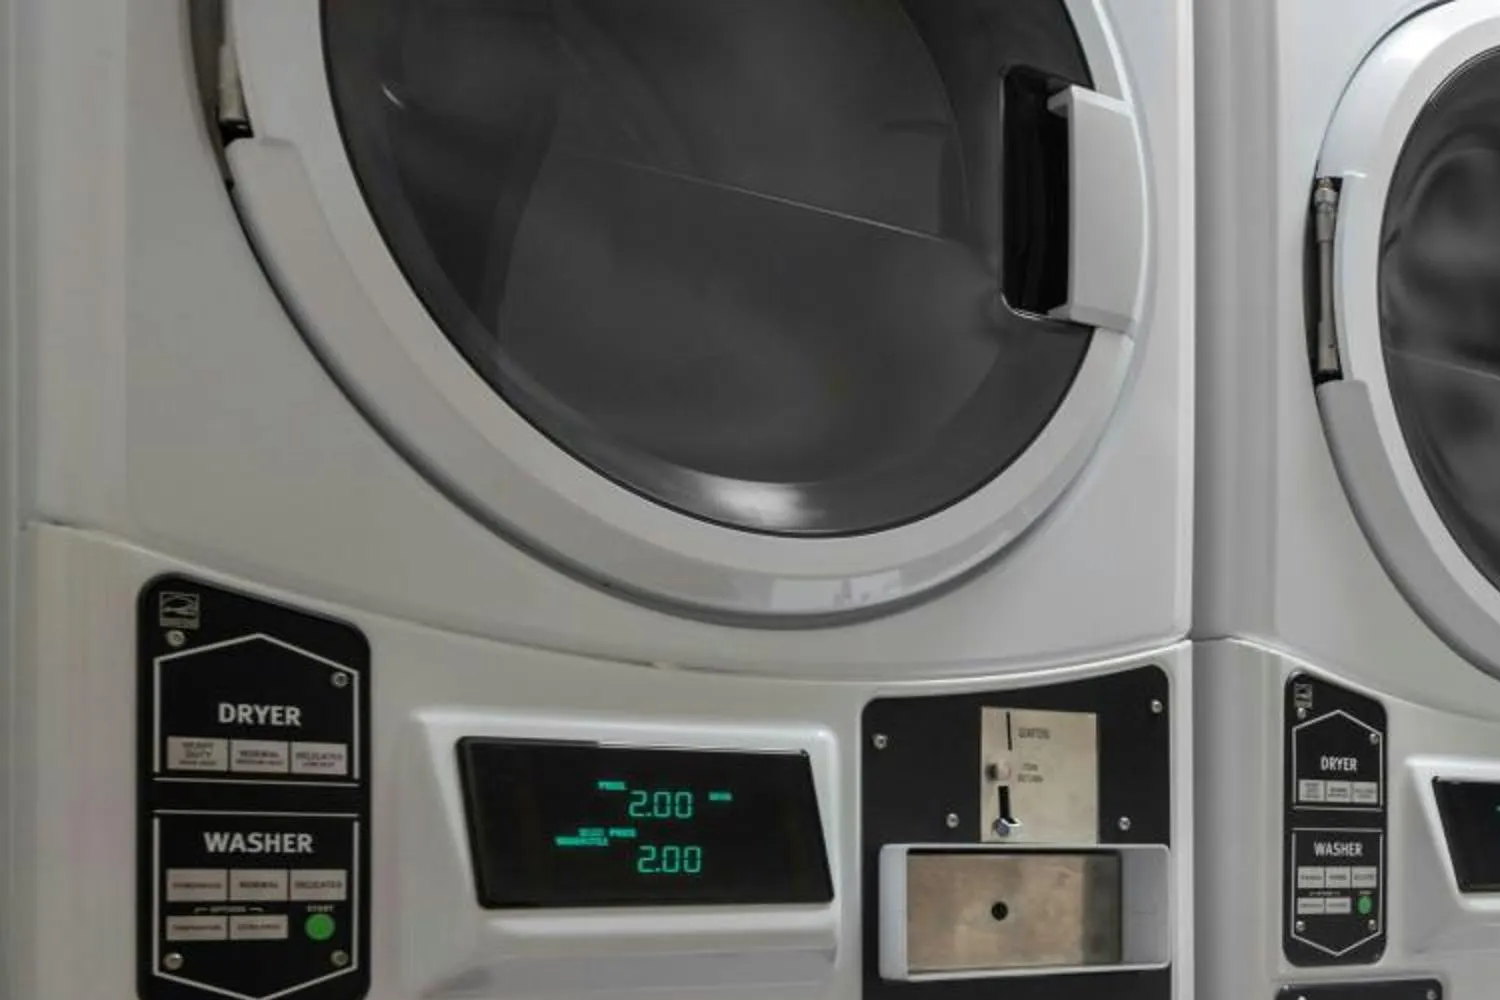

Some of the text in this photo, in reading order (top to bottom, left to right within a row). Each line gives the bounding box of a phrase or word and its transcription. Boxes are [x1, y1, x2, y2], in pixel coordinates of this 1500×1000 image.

[218, 703, 302, 727] DRYER
[1320, 755, 1358, 771] DRYER
[628, 790, 694, 818] 2.00
[204, 831, 315, 854] WASHER
[1313, 841, 1363, 857] WASHER
[637, 845, 702, 873] 2.00
